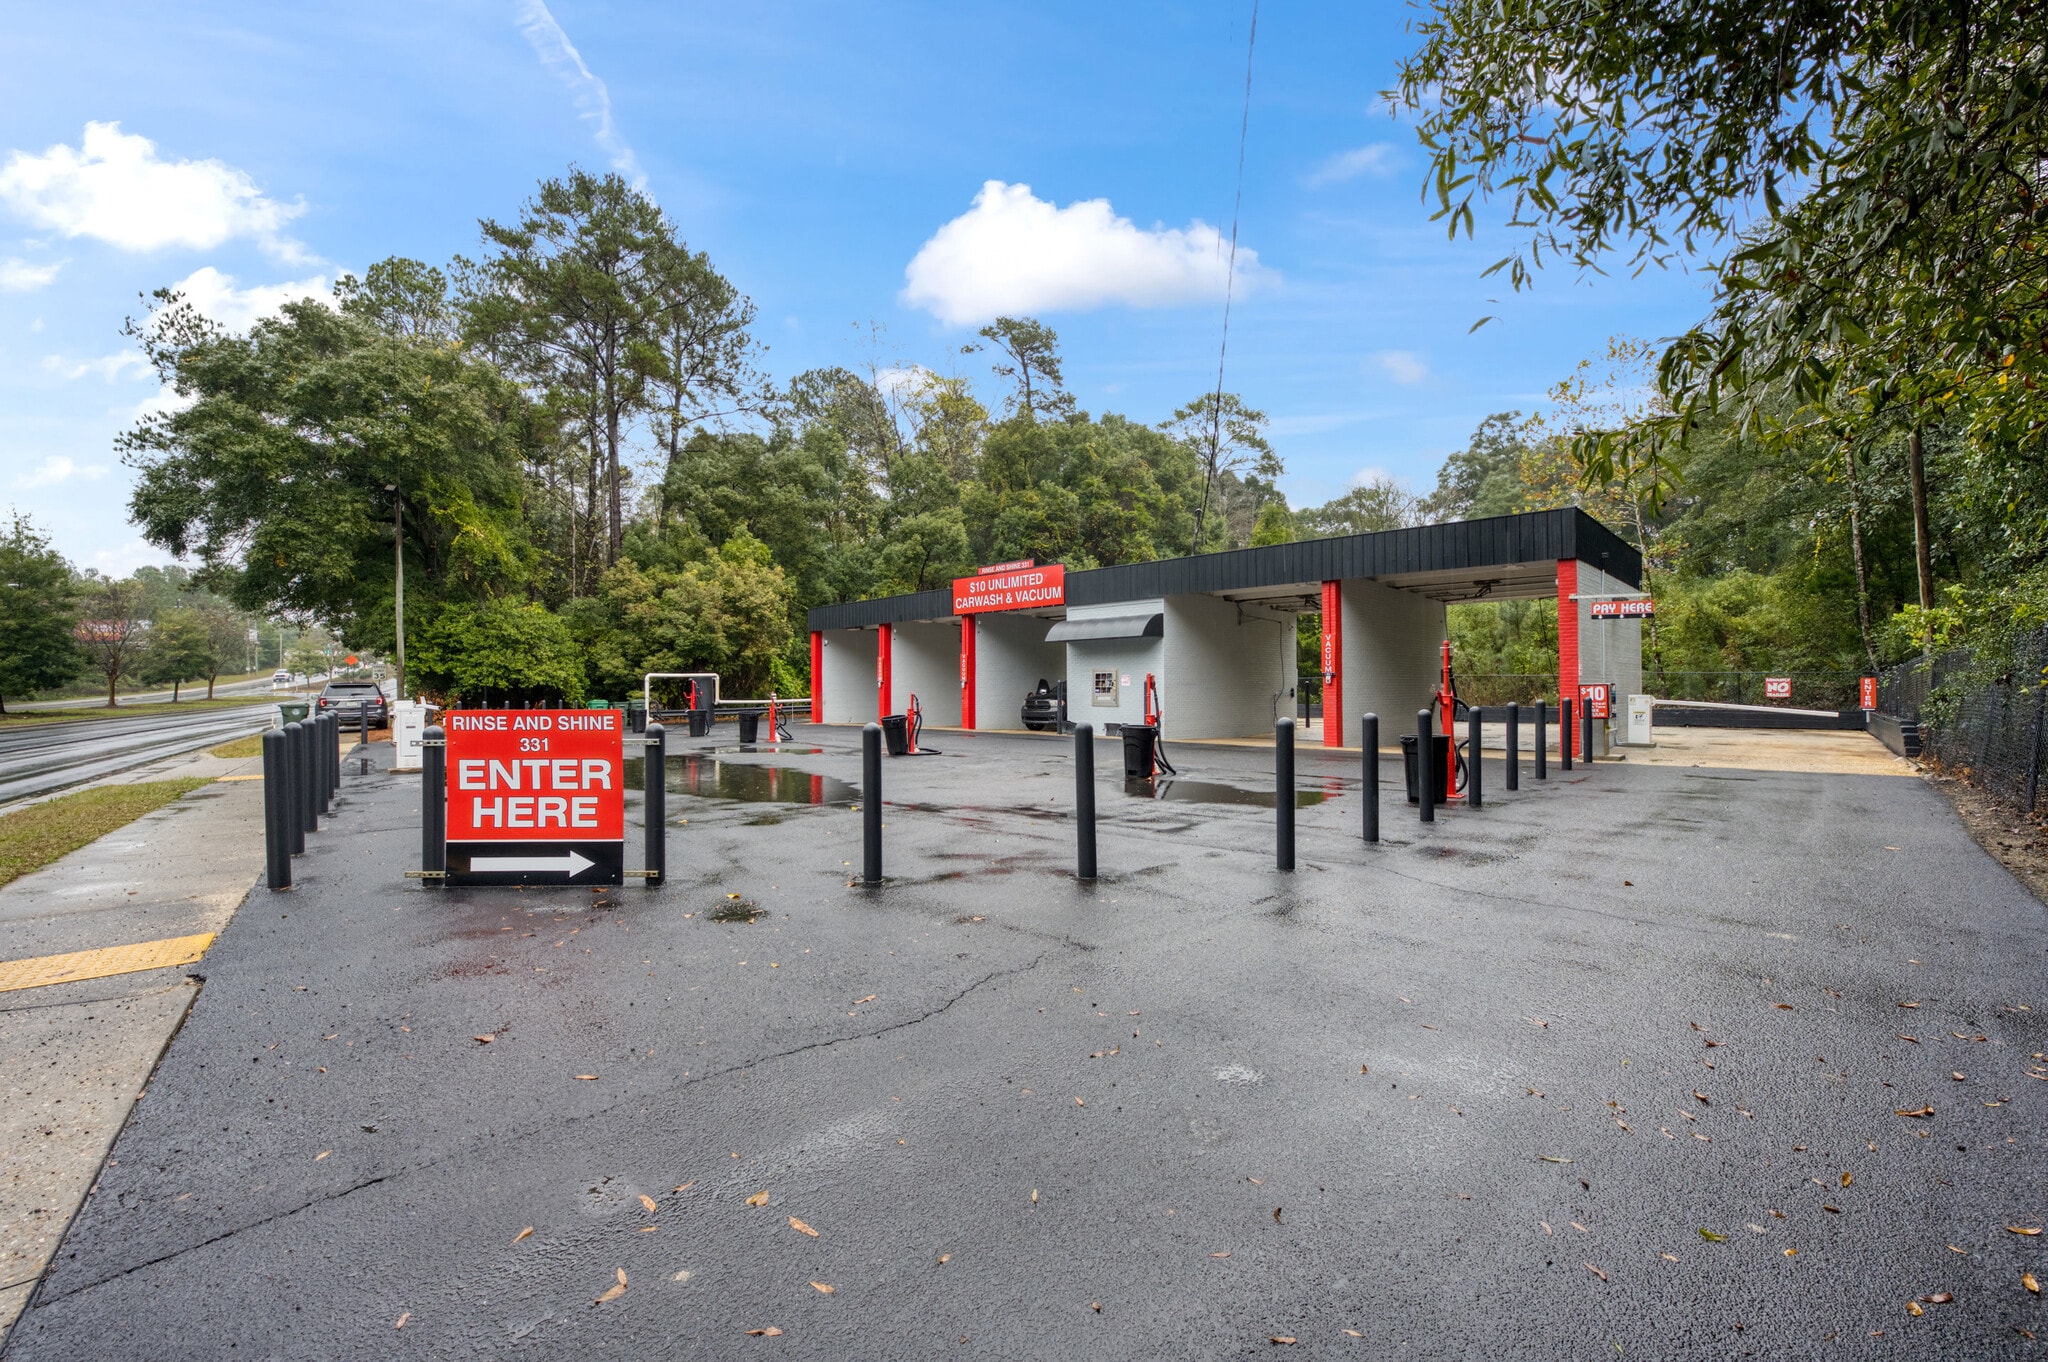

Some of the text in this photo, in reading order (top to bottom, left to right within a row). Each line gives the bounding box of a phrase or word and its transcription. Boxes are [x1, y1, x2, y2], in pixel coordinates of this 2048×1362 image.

[969, 572, 1044, 594] $10 UNLIMITED
[955, 586, 1062, 610] CARWASH & VACUUM
[1593, 602, 1652, 614] PAY HERE
[1580, 686, 1605, 701] $10
[1767, 682, 1789, 693] NO
[1864, 678, 1872, 706] ENTER
[452, 715, 615, 731] RINSE AND SHINE
[520, 737, 549, 752] 331
[458, 758, 612, 790] ENTER
[472, 796, 599, 828] HERE
